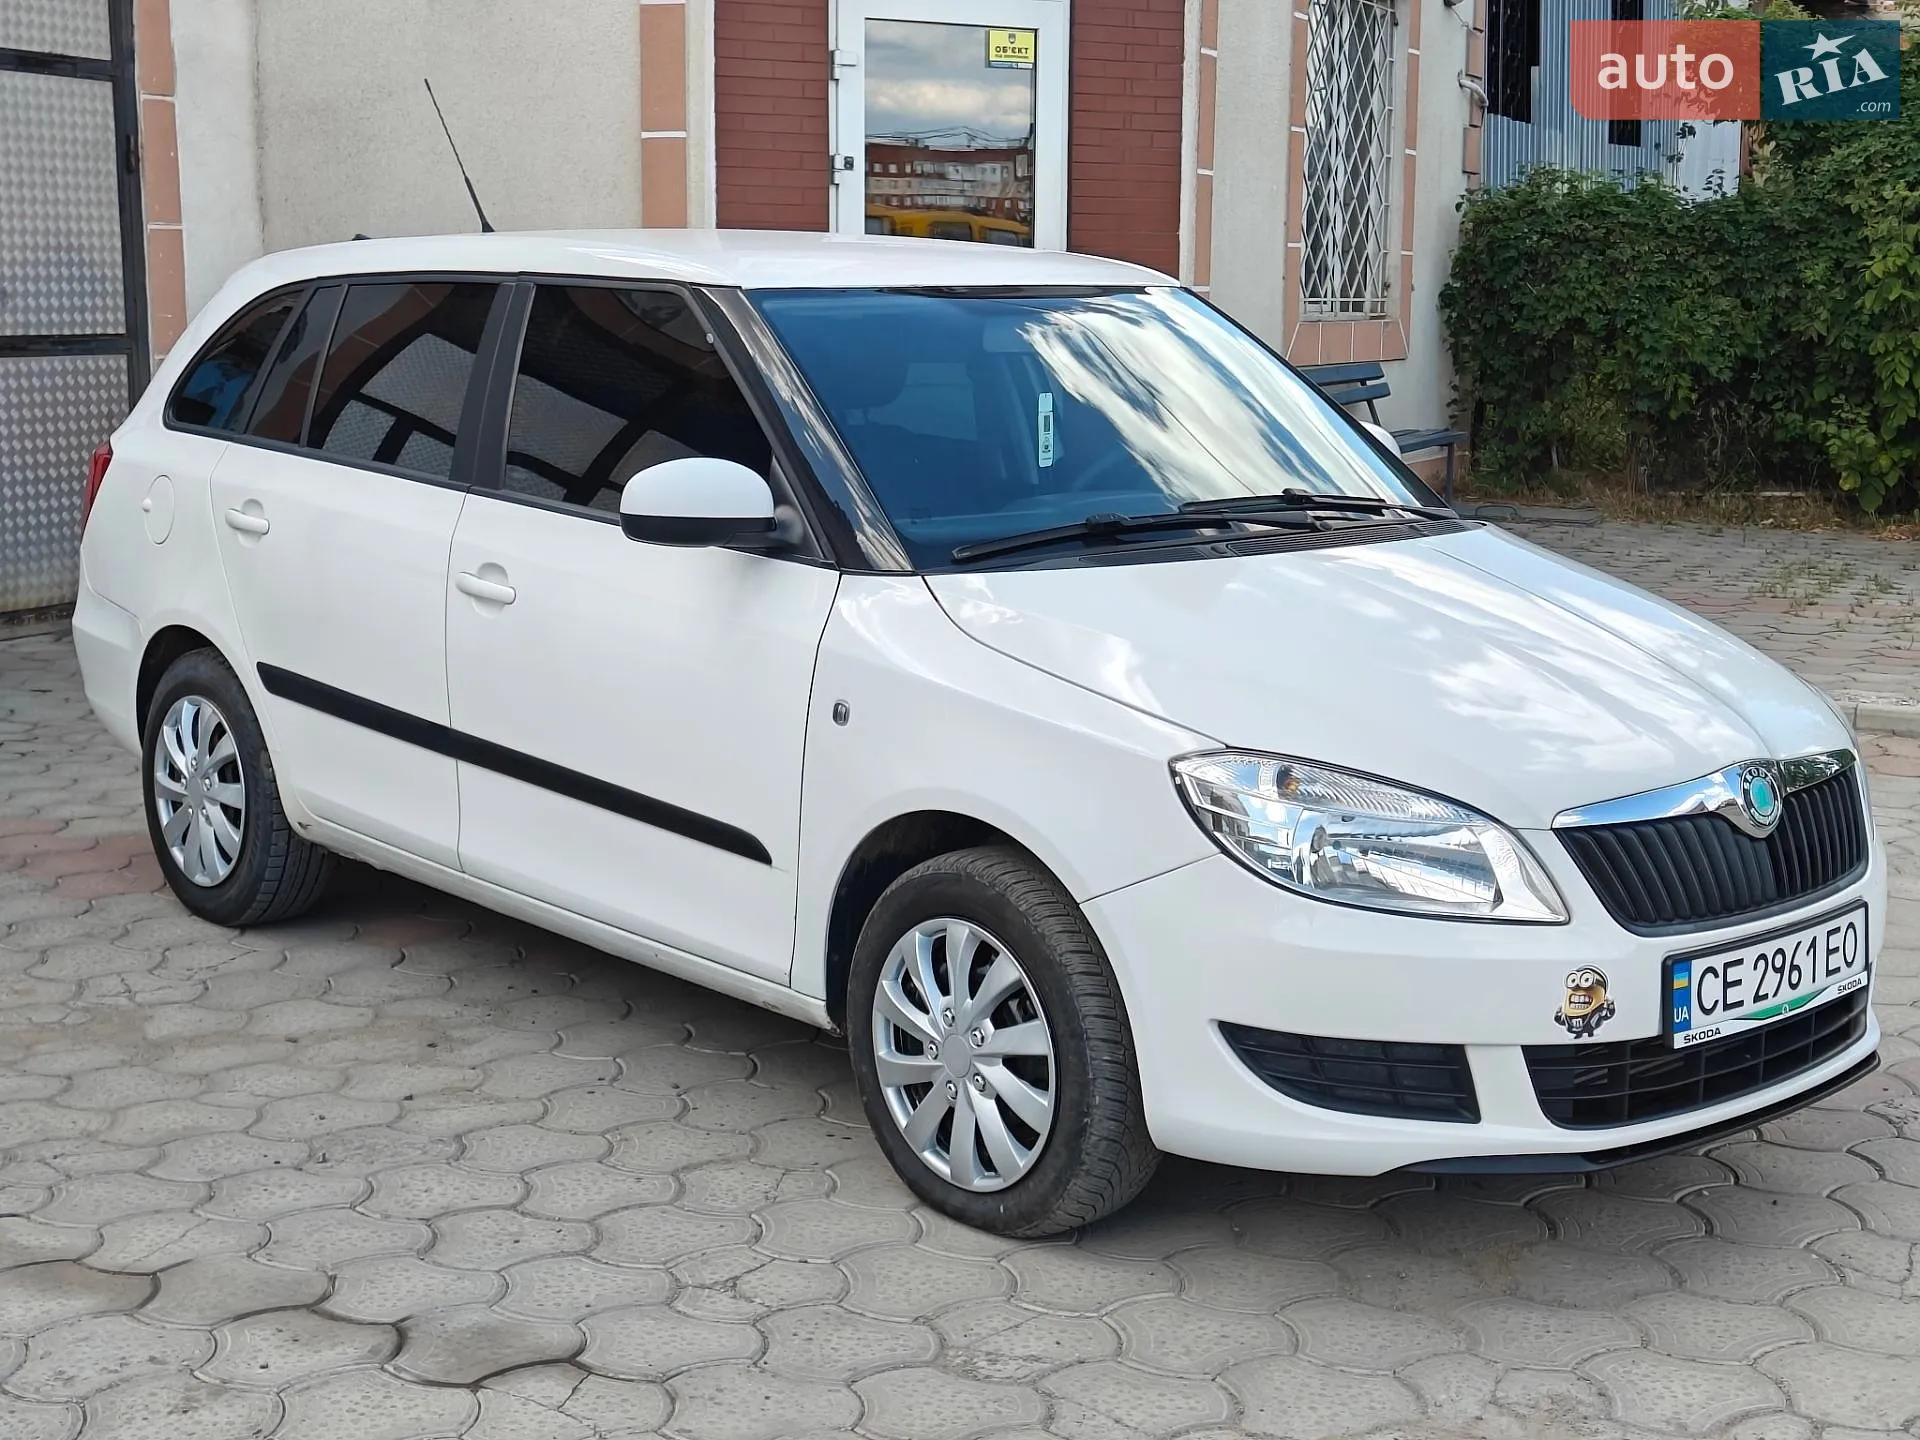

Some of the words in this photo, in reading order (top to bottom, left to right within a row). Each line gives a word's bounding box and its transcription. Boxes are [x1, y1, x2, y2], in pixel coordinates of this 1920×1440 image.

[1696, 957, 1745, 1016] CE
[1752, 935, 1818, 1004] 2961
[1825, 921, 1858, 979] EO
[1673, 1006, 1690, 1023] UA
